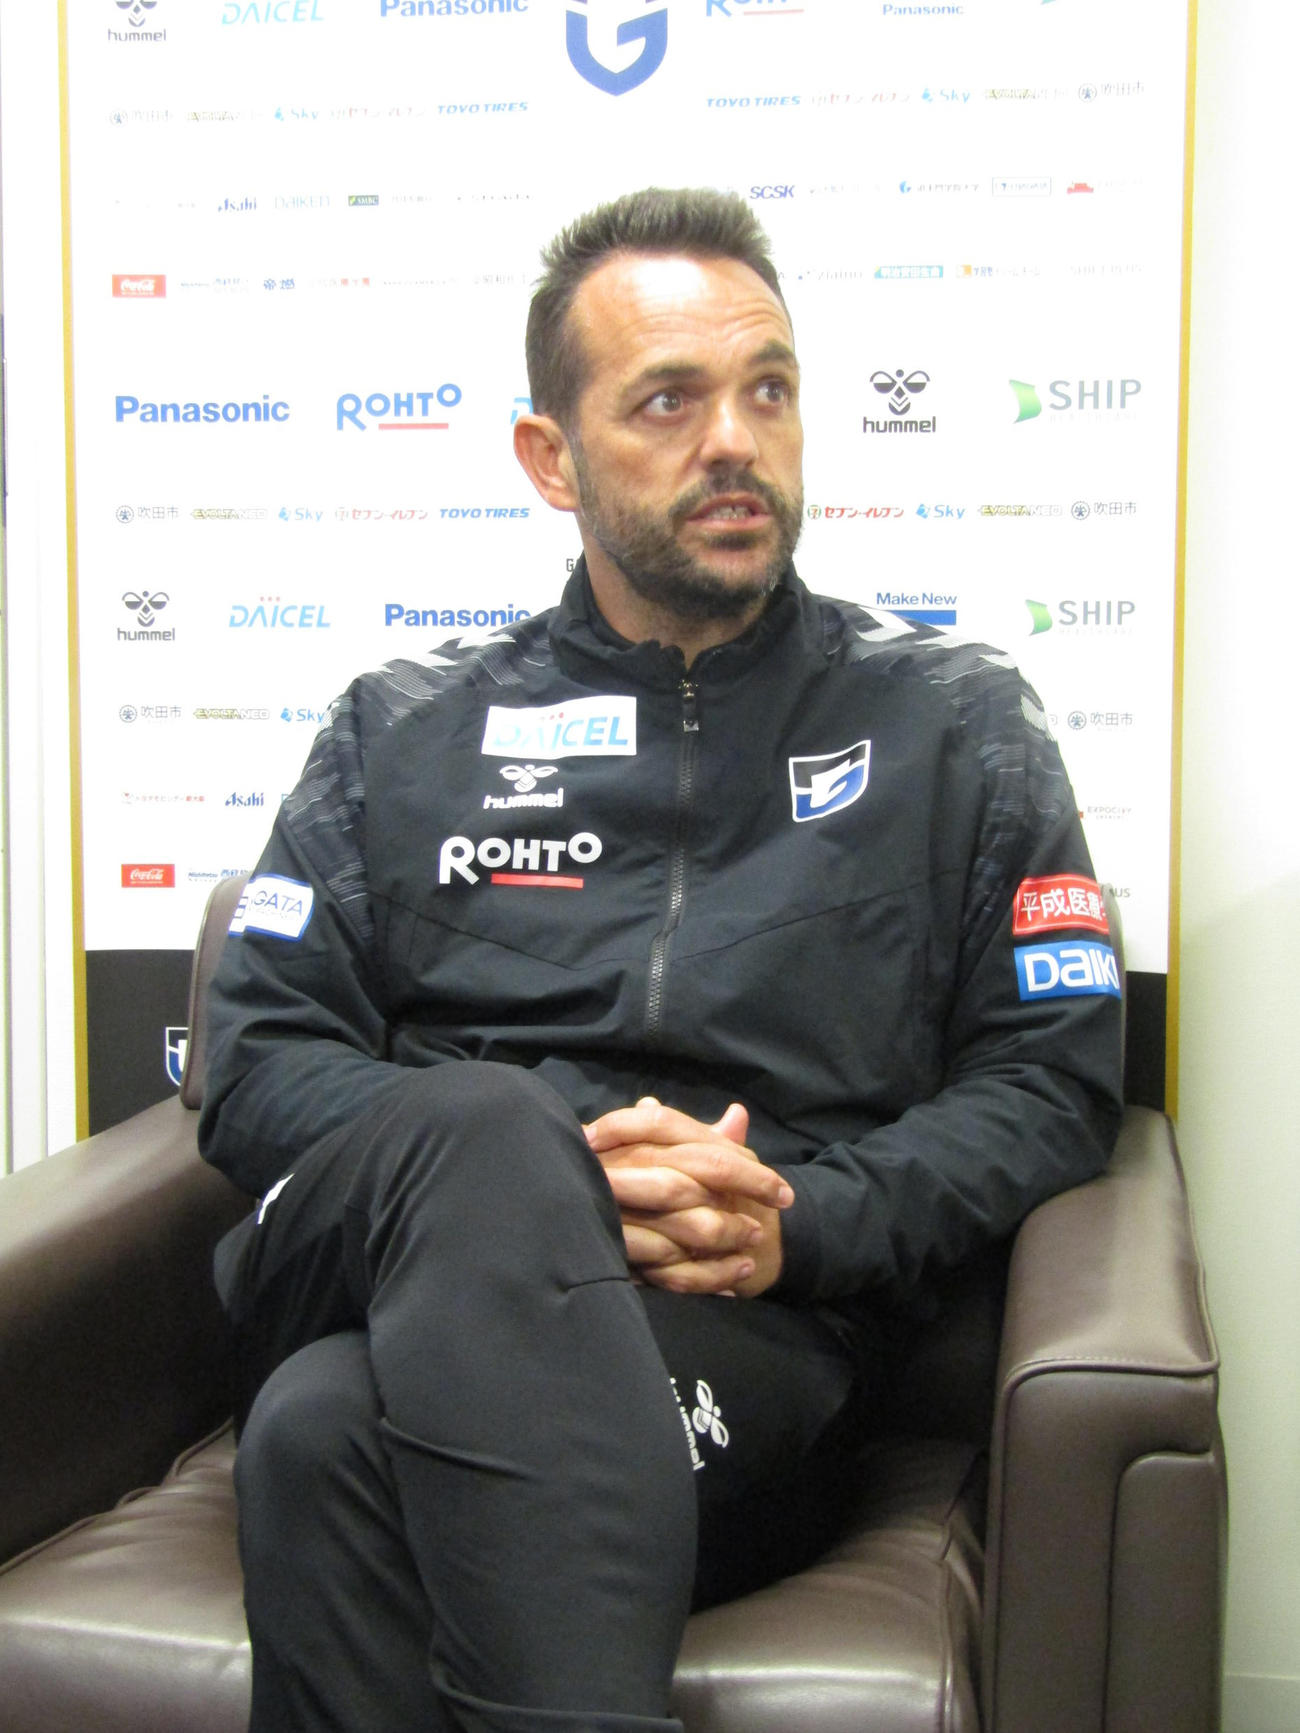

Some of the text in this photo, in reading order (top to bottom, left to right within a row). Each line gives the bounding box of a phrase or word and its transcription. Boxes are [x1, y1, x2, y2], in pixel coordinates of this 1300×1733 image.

[380, 0, 528, 17] Panasonic
[882, 3, 964, 16] Panasonic
[107, 28, 167, 42] hummel
[754, 95, 801, 107] TIRES
[939, 88, 971, 104] Sky
[483, 101, 528, 112] TIRES
[750, 185, 795, 199] SCSK
[1049, 379, 1142, 411] SHIP
[115, 395, 290, 423] Panasonic
[337, 383, 462, 431] ROHTO
[863, 416, 936, 433] hummel
[294, 507, 324, 522] Sky
[484, 508, 530, 518] TIRES
[933, 505, 966, 519] Sky
[1093, 501, 1137, 516] 吹田市
[875, 592, 958, 606] Make New
[229, 605, 331, 628] DAICEL
[1057, 600, 1136, 626] SHIP
[116, 627, 176, 642] hummel
[140, 705, 182, 720] 吹田市
[296, 708, 326, 724] Sky
[1090, 712, 1134, 727] 吹田市
[224, 792, 265, 807] Asahi
[482, 787, 564, 810] hummel
[438, 831, 603, 886] ROHTO
